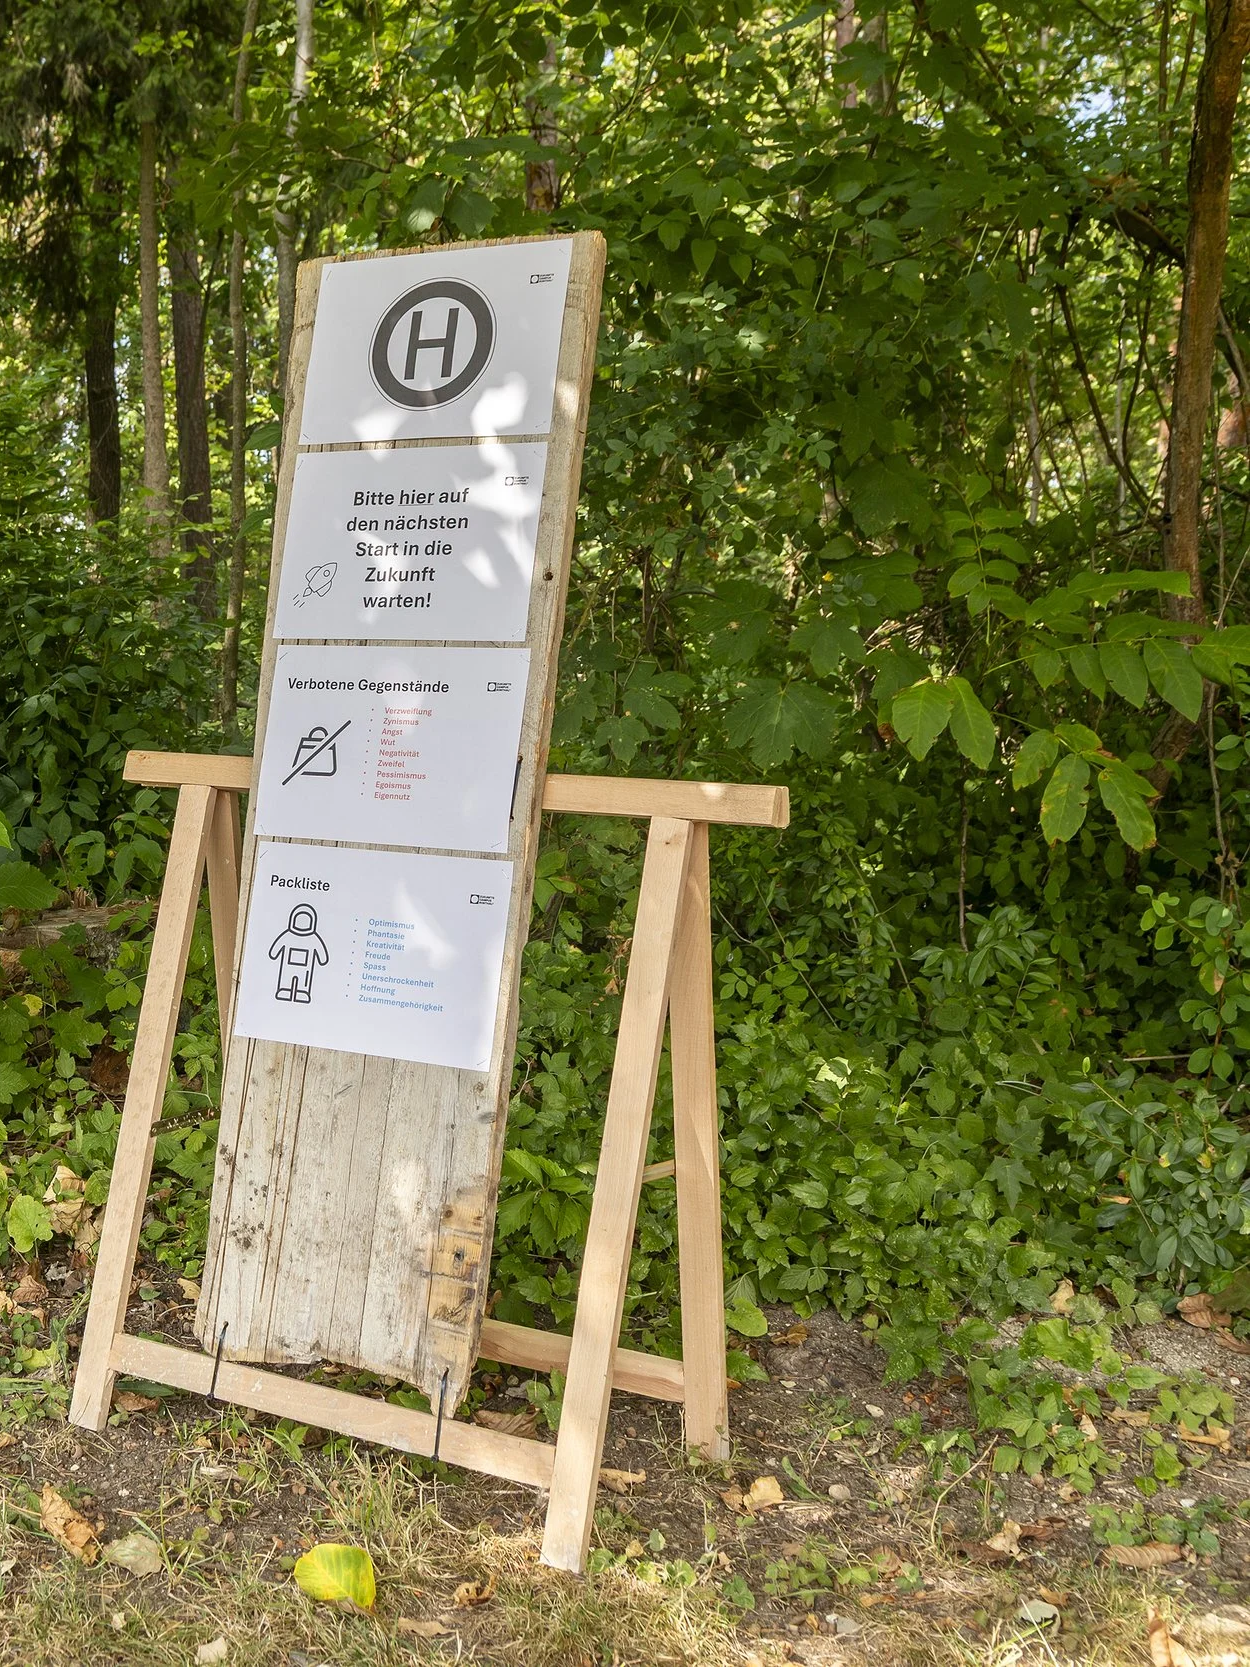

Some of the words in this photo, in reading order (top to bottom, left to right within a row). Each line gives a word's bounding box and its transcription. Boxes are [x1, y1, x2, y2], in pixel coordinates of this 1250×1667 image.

[404, 308, 460, 380] H
[353, 491, 394, 506] Bitte
[399, 490, 434, 506] hier
[438, 488, 469, 503] auf
[346, 517, 378, 532] den
[384, 516, 468, 531] nächsten
[356, 542, 398, 557] Start
[403, 541, 419, 556] in
[424, 540, 452, 555] die
[365, 567, 435, 582] Zukunft
[363, 593, 432, 608] warten!
[288, 678, 355, 690] Verbotene
[358, 679, 449, 694] Gegenstände
[384, 707, 432, 716] Verzweiflung
[383, 718, 419, 726] Zynismus
[381, 728, 403, 736] Angst
[380, 738, 395, 746] Wut
[379, 749, 419, 758] Negativität
[377, 760, 405, 768] Zweifel
[377, 771, 426, 780] Pessimismus
[375, 781, 411, 790] Egoismus
[374, 792, 410, 800] Eigennutz
[270, 875, 330, 891] Packliste
[369, 918, 415, 930] Optimismus
[367, 929, 405, 940] Phantasie
[366, 940, 405, 951] Kreativität
[365, 951, 391, 960] Freude
[363, 962, 386, 971] Spass
[362, 973, 434, 988] Unerschrockenheit
[360, 984, 395, 995] Hoffnung
[358, 994, 443, 1012] Zusammengehörigkeit
